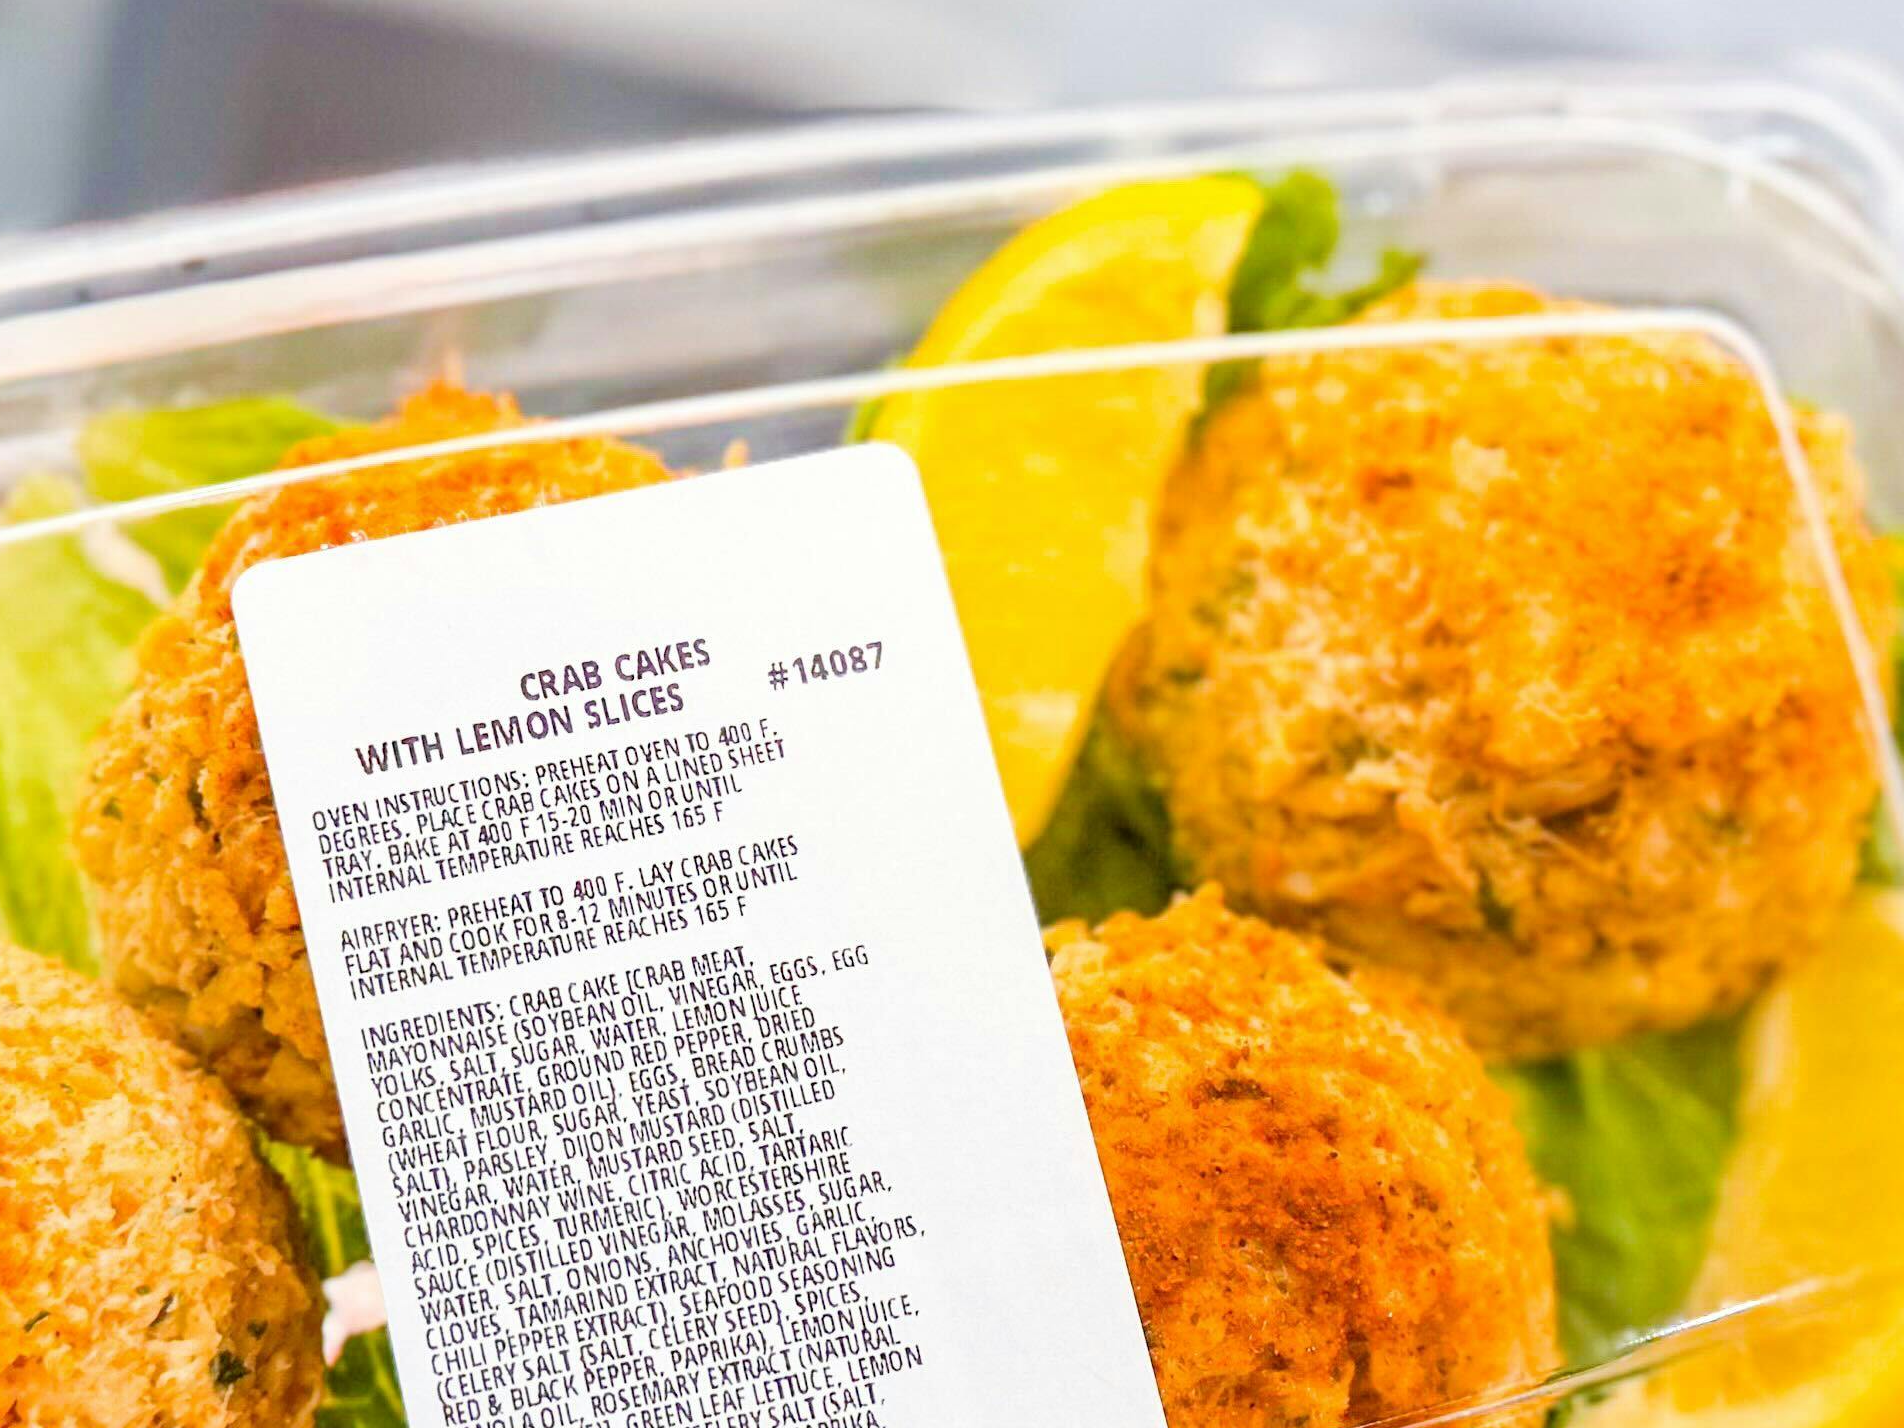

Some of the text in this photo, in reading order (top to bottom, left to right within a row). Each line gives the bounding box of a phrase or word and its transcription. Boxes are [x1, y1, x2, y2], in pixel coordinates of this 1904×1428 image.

[519, 637, 711, 702] CRAB CAKES
[767, 640, 883, 691] #14087
[354, 681, 685, 776] WITH LEMON SLICES
[311, 800, 370, 832] OVEN
[374, 769, 530, 820] INSTRUCTIONS:
[534, 748, 620, 786] PREHEAT
[623, 736, 681, 767] OVEN
[683, 730, 710, 754] TO
[717, 721, 753, 747] 400
[386, 835, 442, 866] BAKE
[447, 828, 471, 855] AT
[477, 820, 513, 847] 400
[518, 815, 530, 839] F
[535, 803, 593, 834] 15-20
[598, 792, 645, 822] MIN
[646, 785, 679, 811] OR
[679, 772, 743, 804] UNTIL
[415, 802, 478, 836] PLACE
[480, 790, 535, 822] CRAB
[538, 777, 602, 809] CAKES
[605, 768, 640, 795] ON
[646, 765, 662, 788] A
[663, 751, 724, 783] LINED
[726, 737, 785, 770] SHEET
[327, 799, 724, 904] INTERNAL TEMPERATURE REACHES 165 F
[340, 912, 442, 953] AIRFRYER:
[446, 889, 534, 930] PREHEAT
[537, 884, 565, 910] TO
[572, 874, 608, 902] 400
[637, 859, 674, 889] LAY
[679, 848, 734, 879] CRAB
[736, 833, 799, 867] CAKES
[343, 860, 799, 977] FLAT AND COOK FOR 8-12 MINUTES OR UNTIL
[349, 894, 747, 1001] INTERNAL TEMPERATURE REACHES 165 F
[360, 1000, 505, 1051] INGREDIENTS:
[508, 985, 564, 1018] CRAB
[567, 972, 621, 1005] CAKE
[365, 1023, 509, 1075] MAYONNAISE
[830, 943, 869, 972] EGG
[536, 1049, 626, 1088] GROUND
[629, 1039, 668, 1068] RED
[752, 1005, 816, 1039] DRIED
[671, 995, 747, 1033] LEMON
[749, 983, 803, 1017] JUICE
[703, 1059, 800, 1102] SOYBEAN
[584, 1138, 684, 1181] MUSTARD
[513, 1282, 629, 1330] TAMARIND
[731, 1236, 828, 1279] NATURAL
[589, 1369, 700, 1419] ROSEMARY
[706, 1347, 792, 1390] EXTRACT
